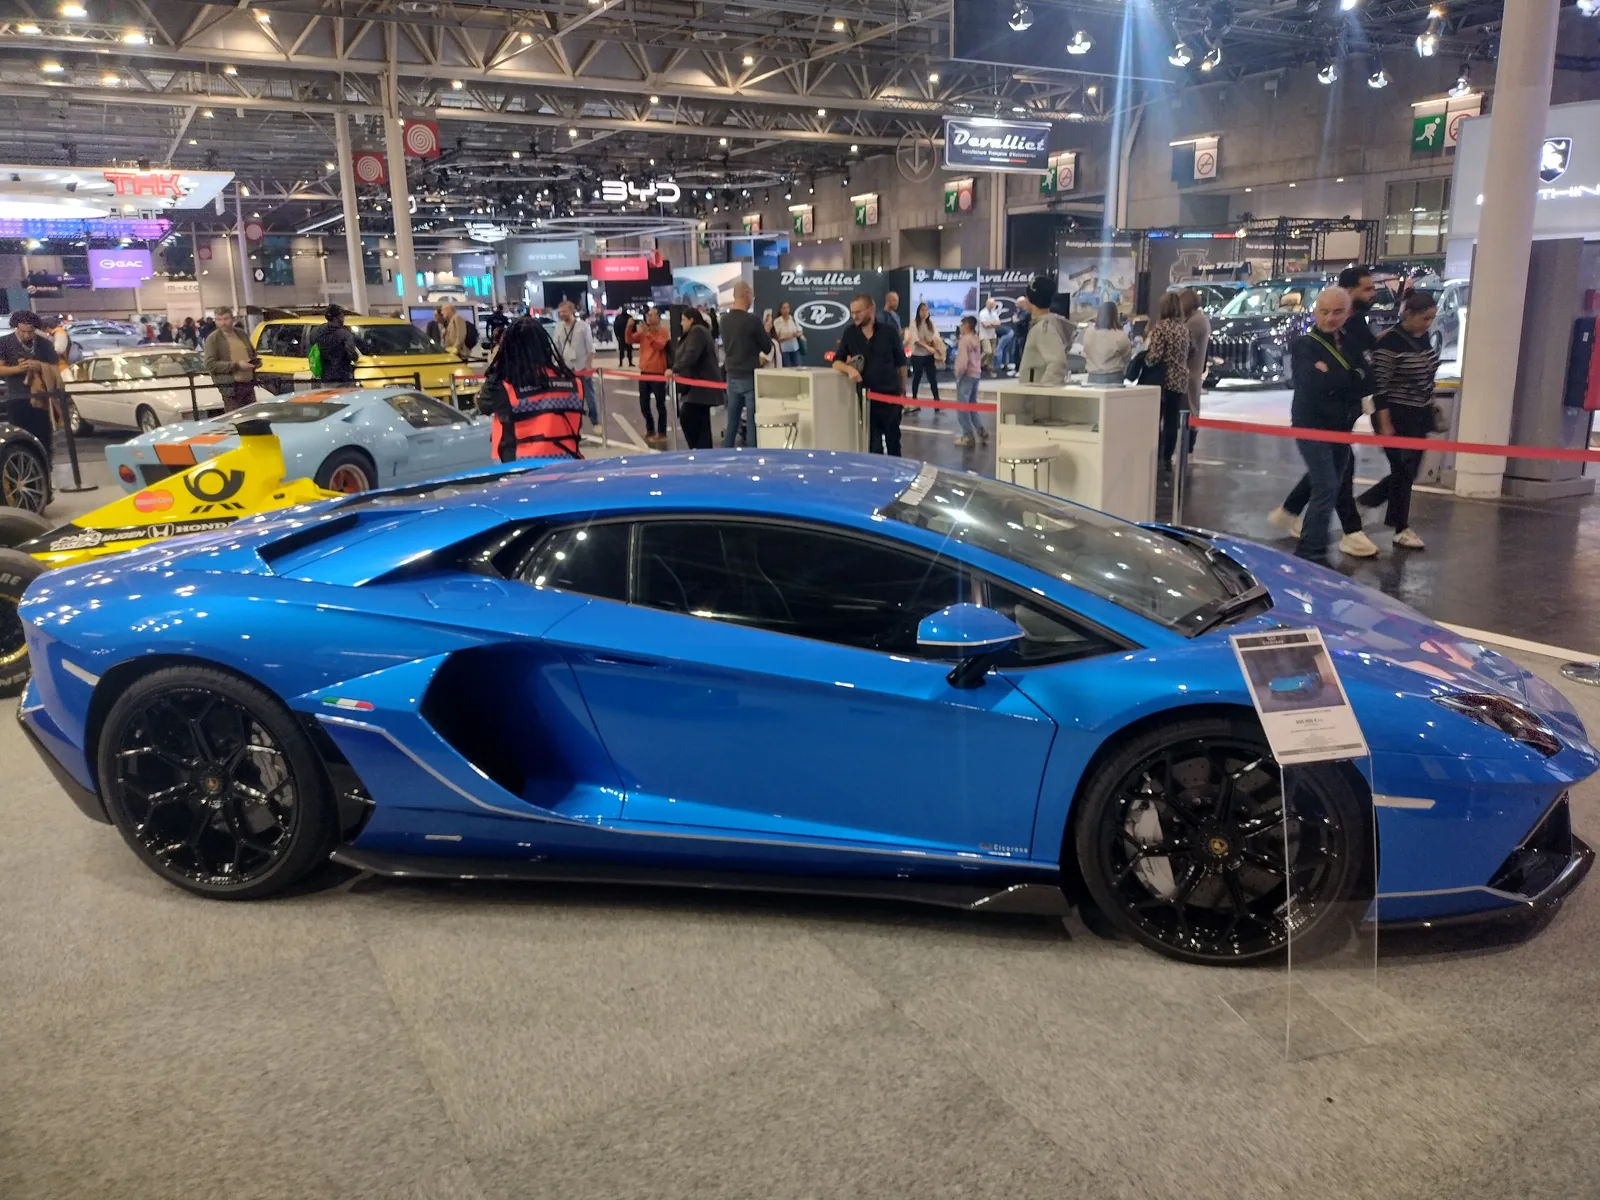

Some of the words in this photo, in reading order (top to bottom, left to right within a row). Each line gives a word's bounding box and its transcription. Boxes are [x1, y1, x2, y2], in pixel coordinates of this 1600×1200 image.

[601, 180, 681, 203] BYD
[115, 260, 143, 268] GAC
[780, 271, 861, 285] Devalliet
[101, 531, 146, 542] MUGEN
